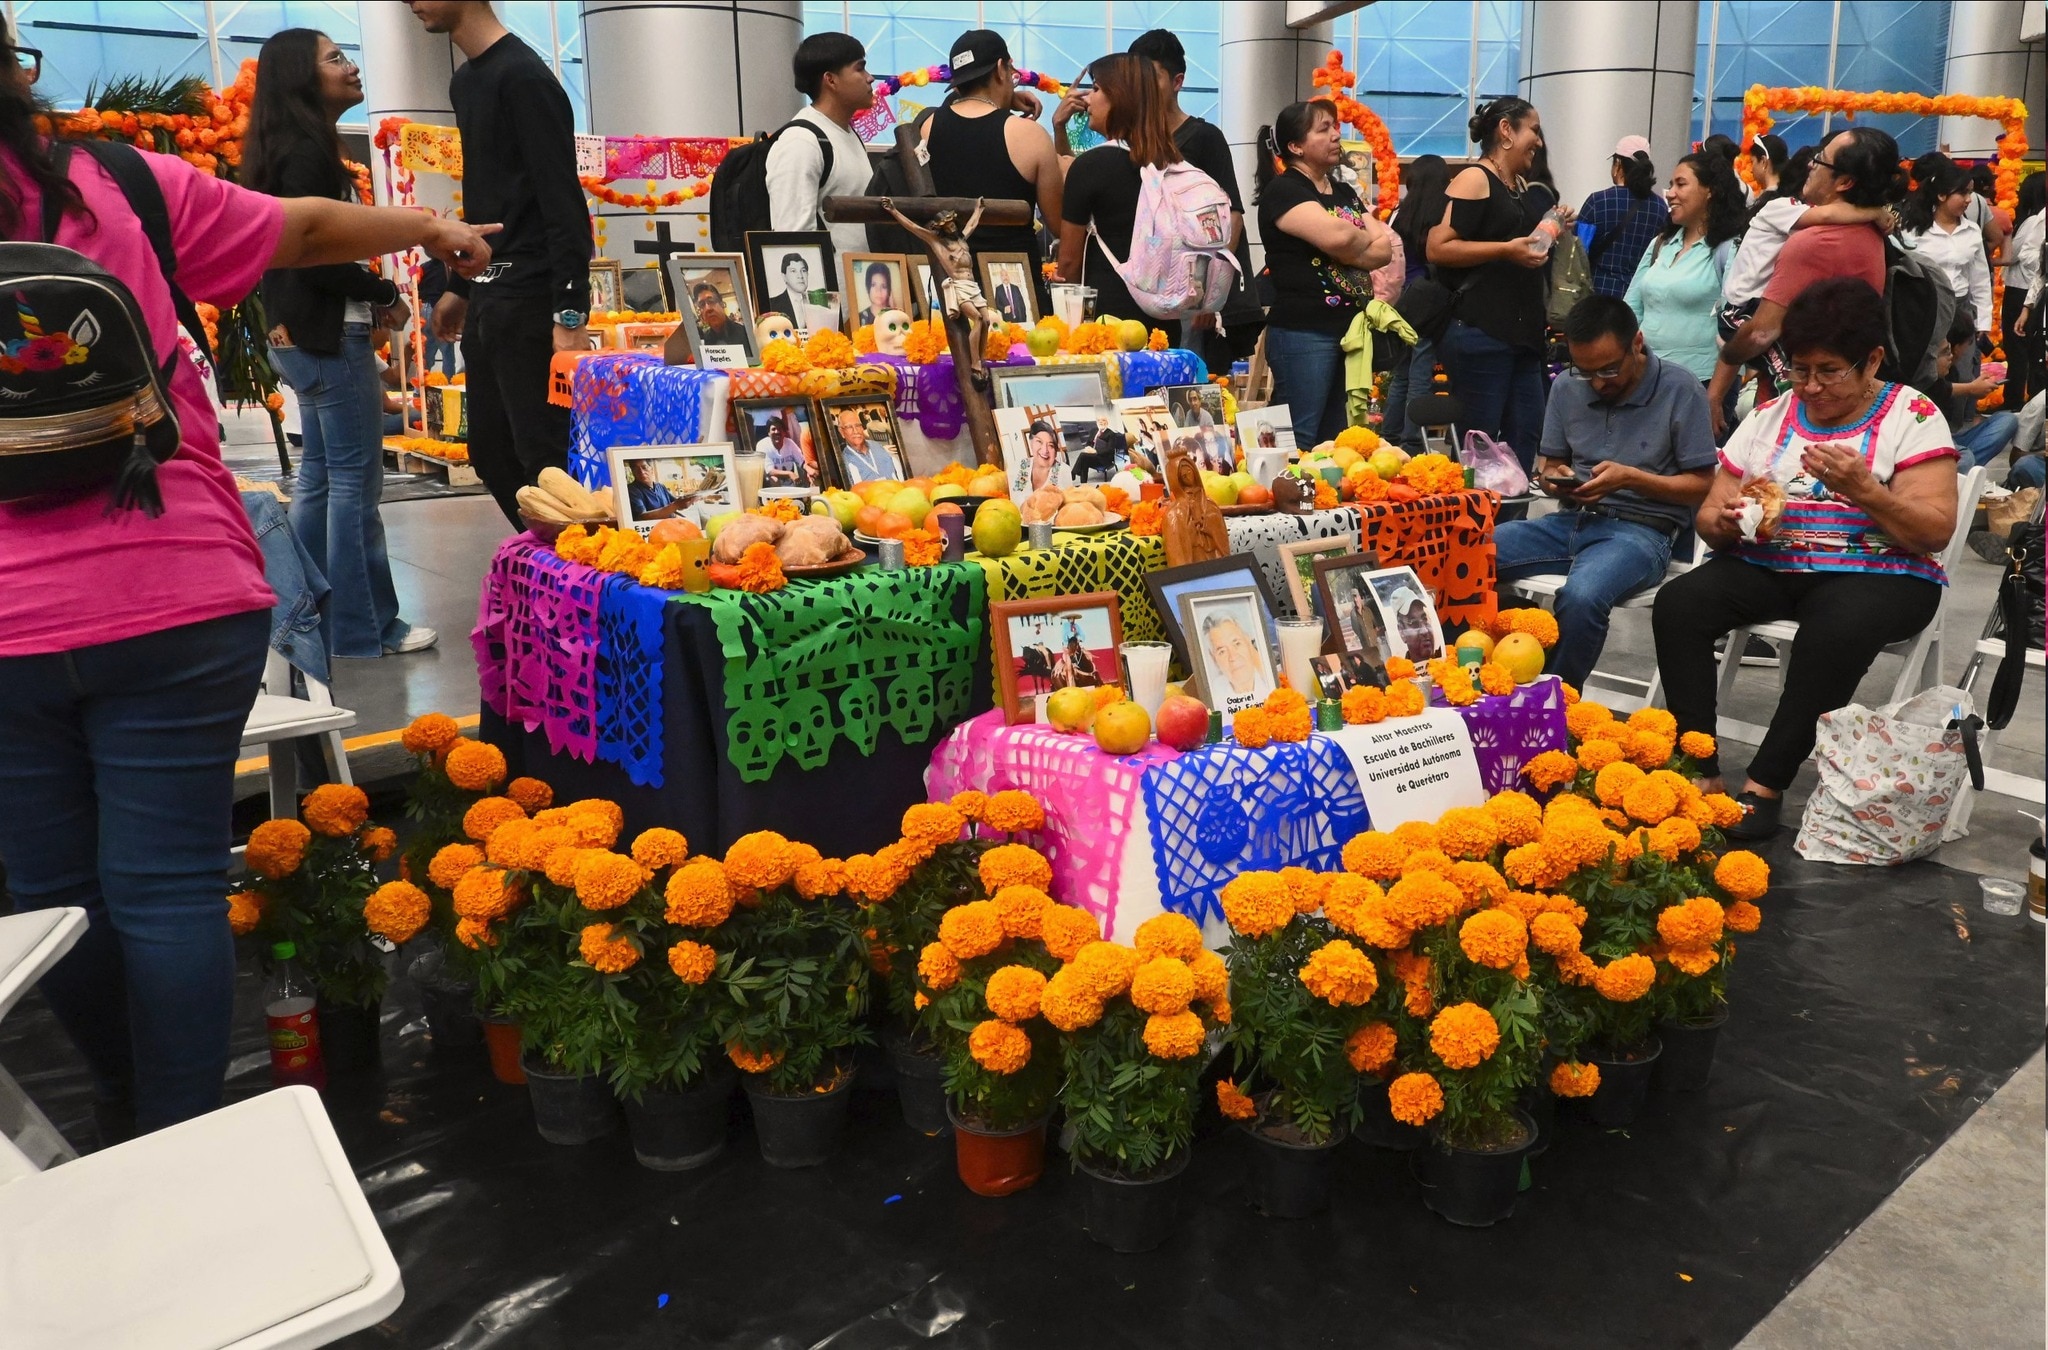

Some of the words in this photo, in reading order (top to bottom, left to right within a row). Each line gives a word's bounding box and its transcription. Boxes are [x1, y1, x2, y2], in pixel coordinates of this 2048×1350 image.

[709, 355, 731, 363] Paredes
[1227, 694, 1254, 704] Gabriel
[1371, 733, 1392, 744] Altar
[1394, 721, 1432, 738] Maestros
[1363, 750, 1397, 764] Escuela
[1399, 745, 1409, 755] de
[1410, 732, 1454, 751] Bachilleres
[1369, 760, 1420, 782] Universidad
[1422, 749, 1461, 766] Autónoma
[1396, 783, 1407, 793] de
[1408, 771, 1449, 789] Querétaro
